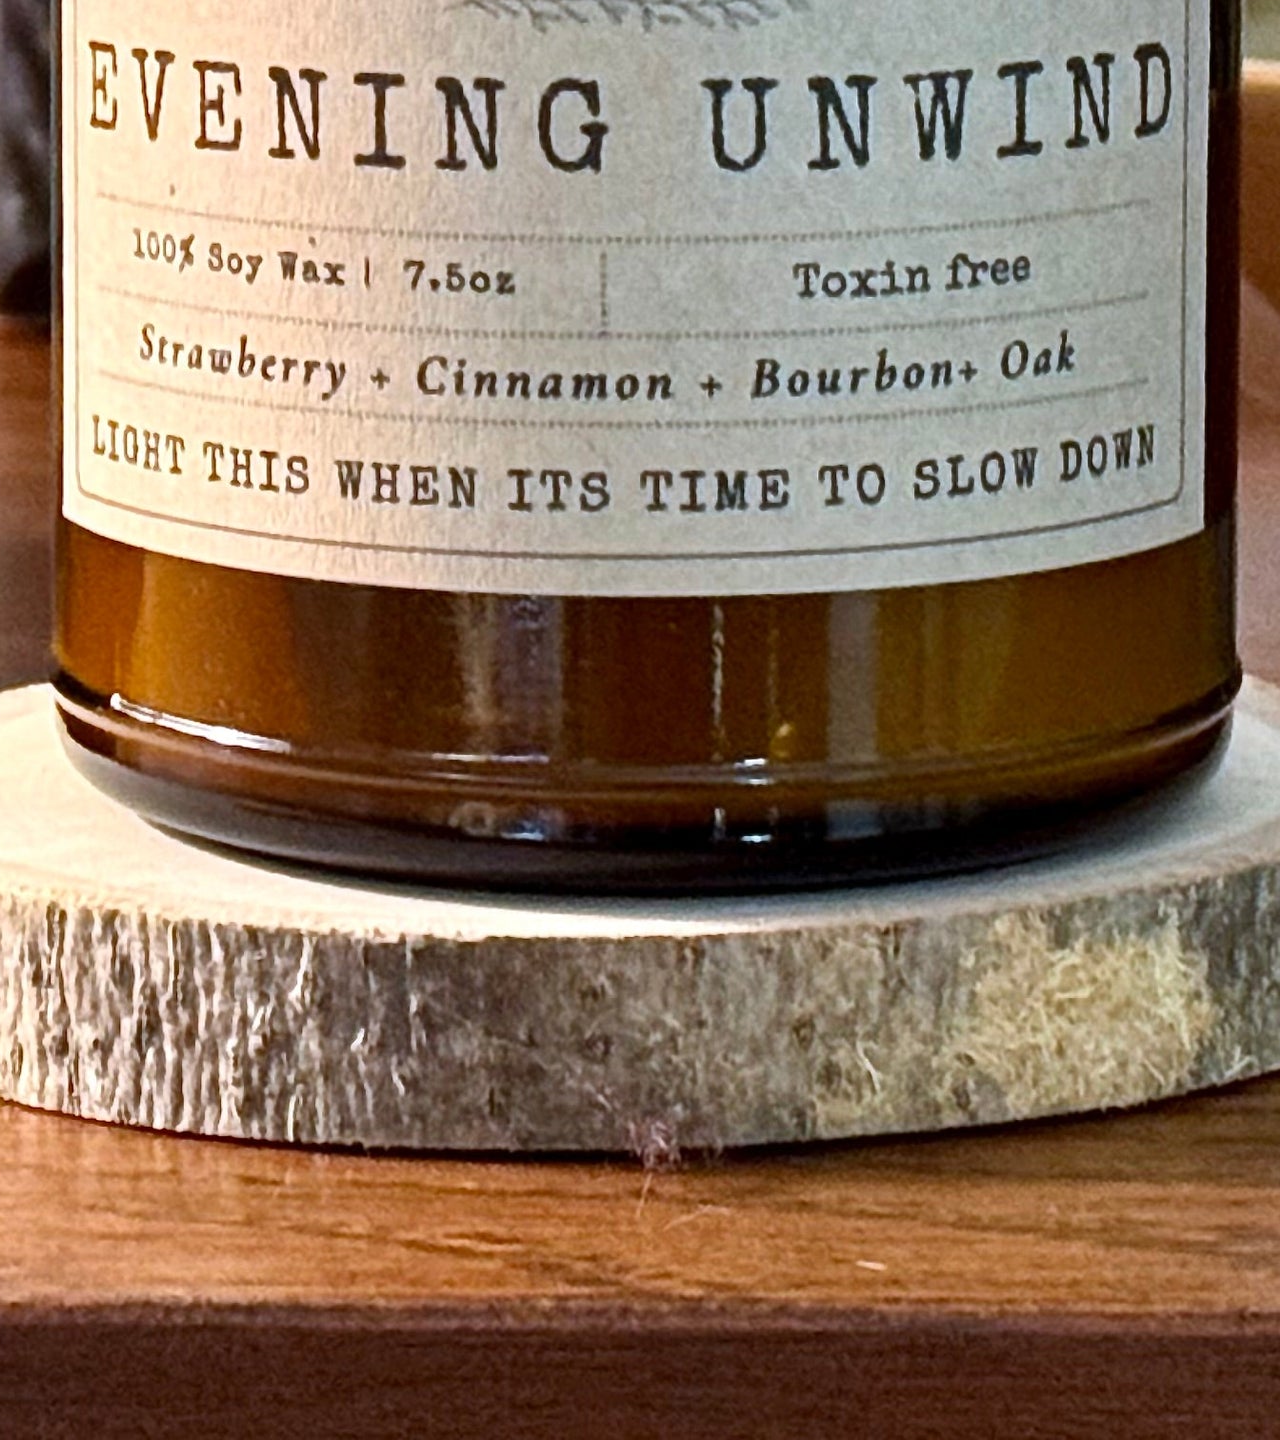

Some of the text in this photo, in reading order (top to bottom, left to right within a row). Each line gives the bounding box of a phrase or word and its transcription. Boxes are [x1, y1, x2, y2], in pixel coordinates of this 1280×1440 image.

[88, 40, 1172, 174] EVENING UNWIND
[132, 228, 196, 273] 100%
[207, 242, 263, 284] Soy
[277, 250, 346, 287] Wax
[402, 259, 516, 296] 7.5oz
[792, 252, 1031, 299] Toxin free
[139, 323, 347, 400] Strawberry
[417, 355, 672, 401] Cinnamon
[1000, 329, 1076, 380] Oak
[91, 414, 1155, 513] LIGHT THIS WHEN ITS TIME TO SLOW DOWN
